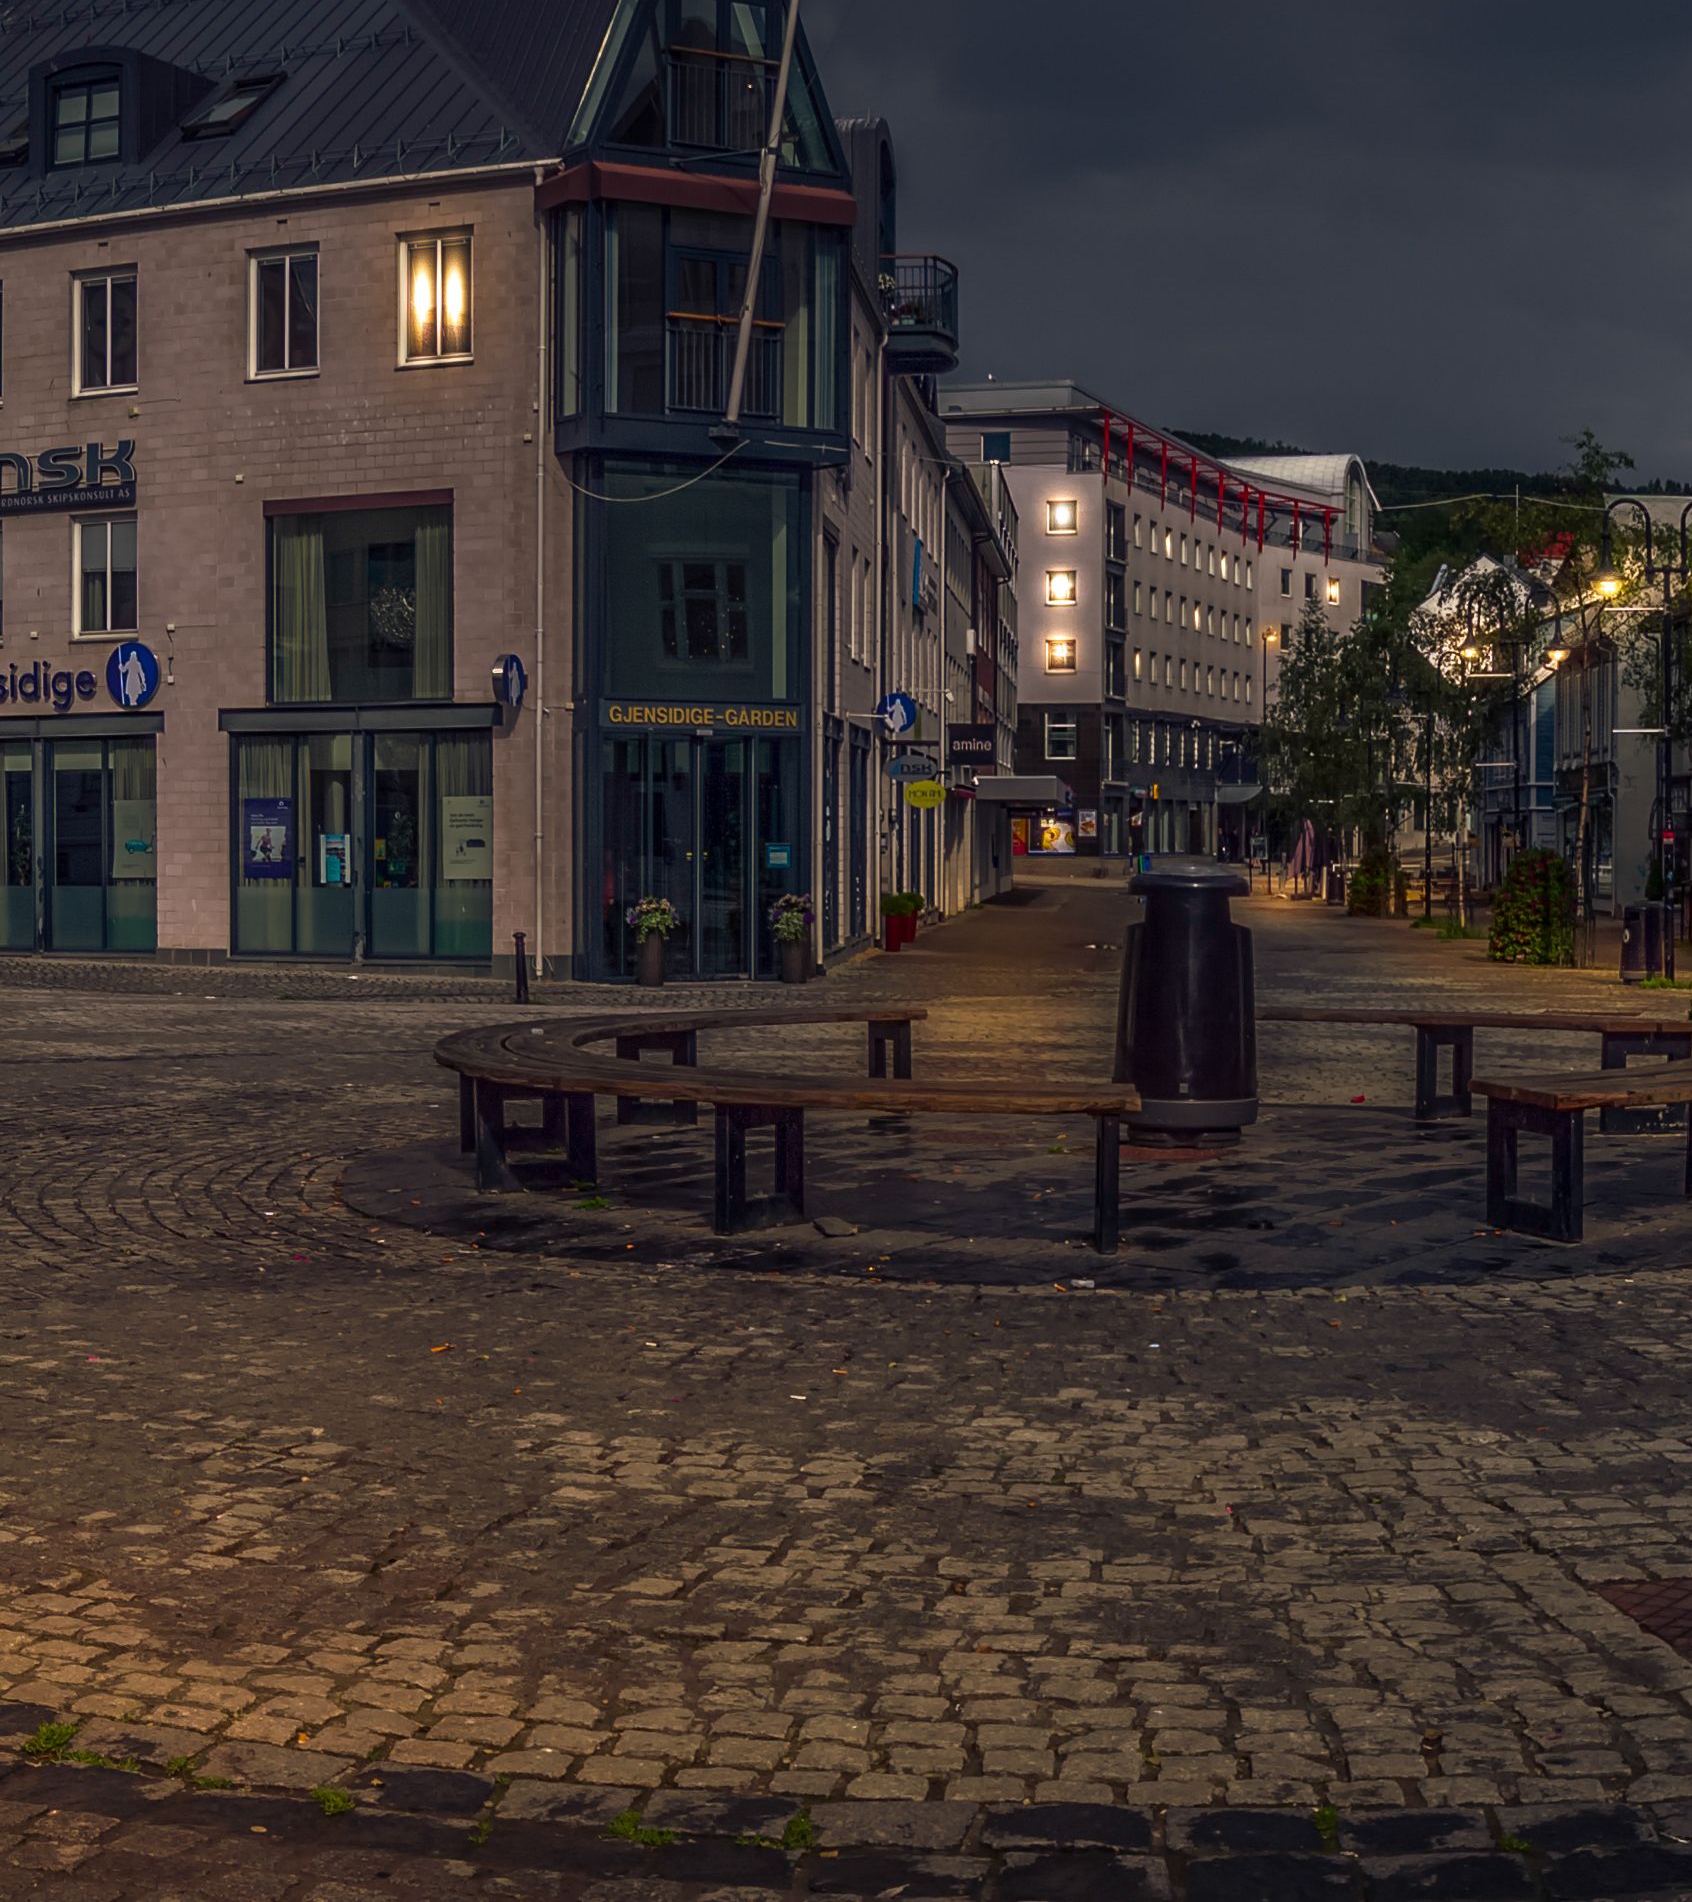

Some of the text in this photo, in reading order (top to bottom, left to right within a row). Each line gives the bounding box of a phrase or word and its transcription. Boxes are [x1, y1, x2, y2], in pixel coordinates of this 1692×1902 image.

[47, 489, 114, 504] SKIPSKONSULT
[118, 488, 130, 498] AS
[608, 705, 797, 727] GJENSIDIGE-GÅRDEN
[952, 738, 992, 751] amine
